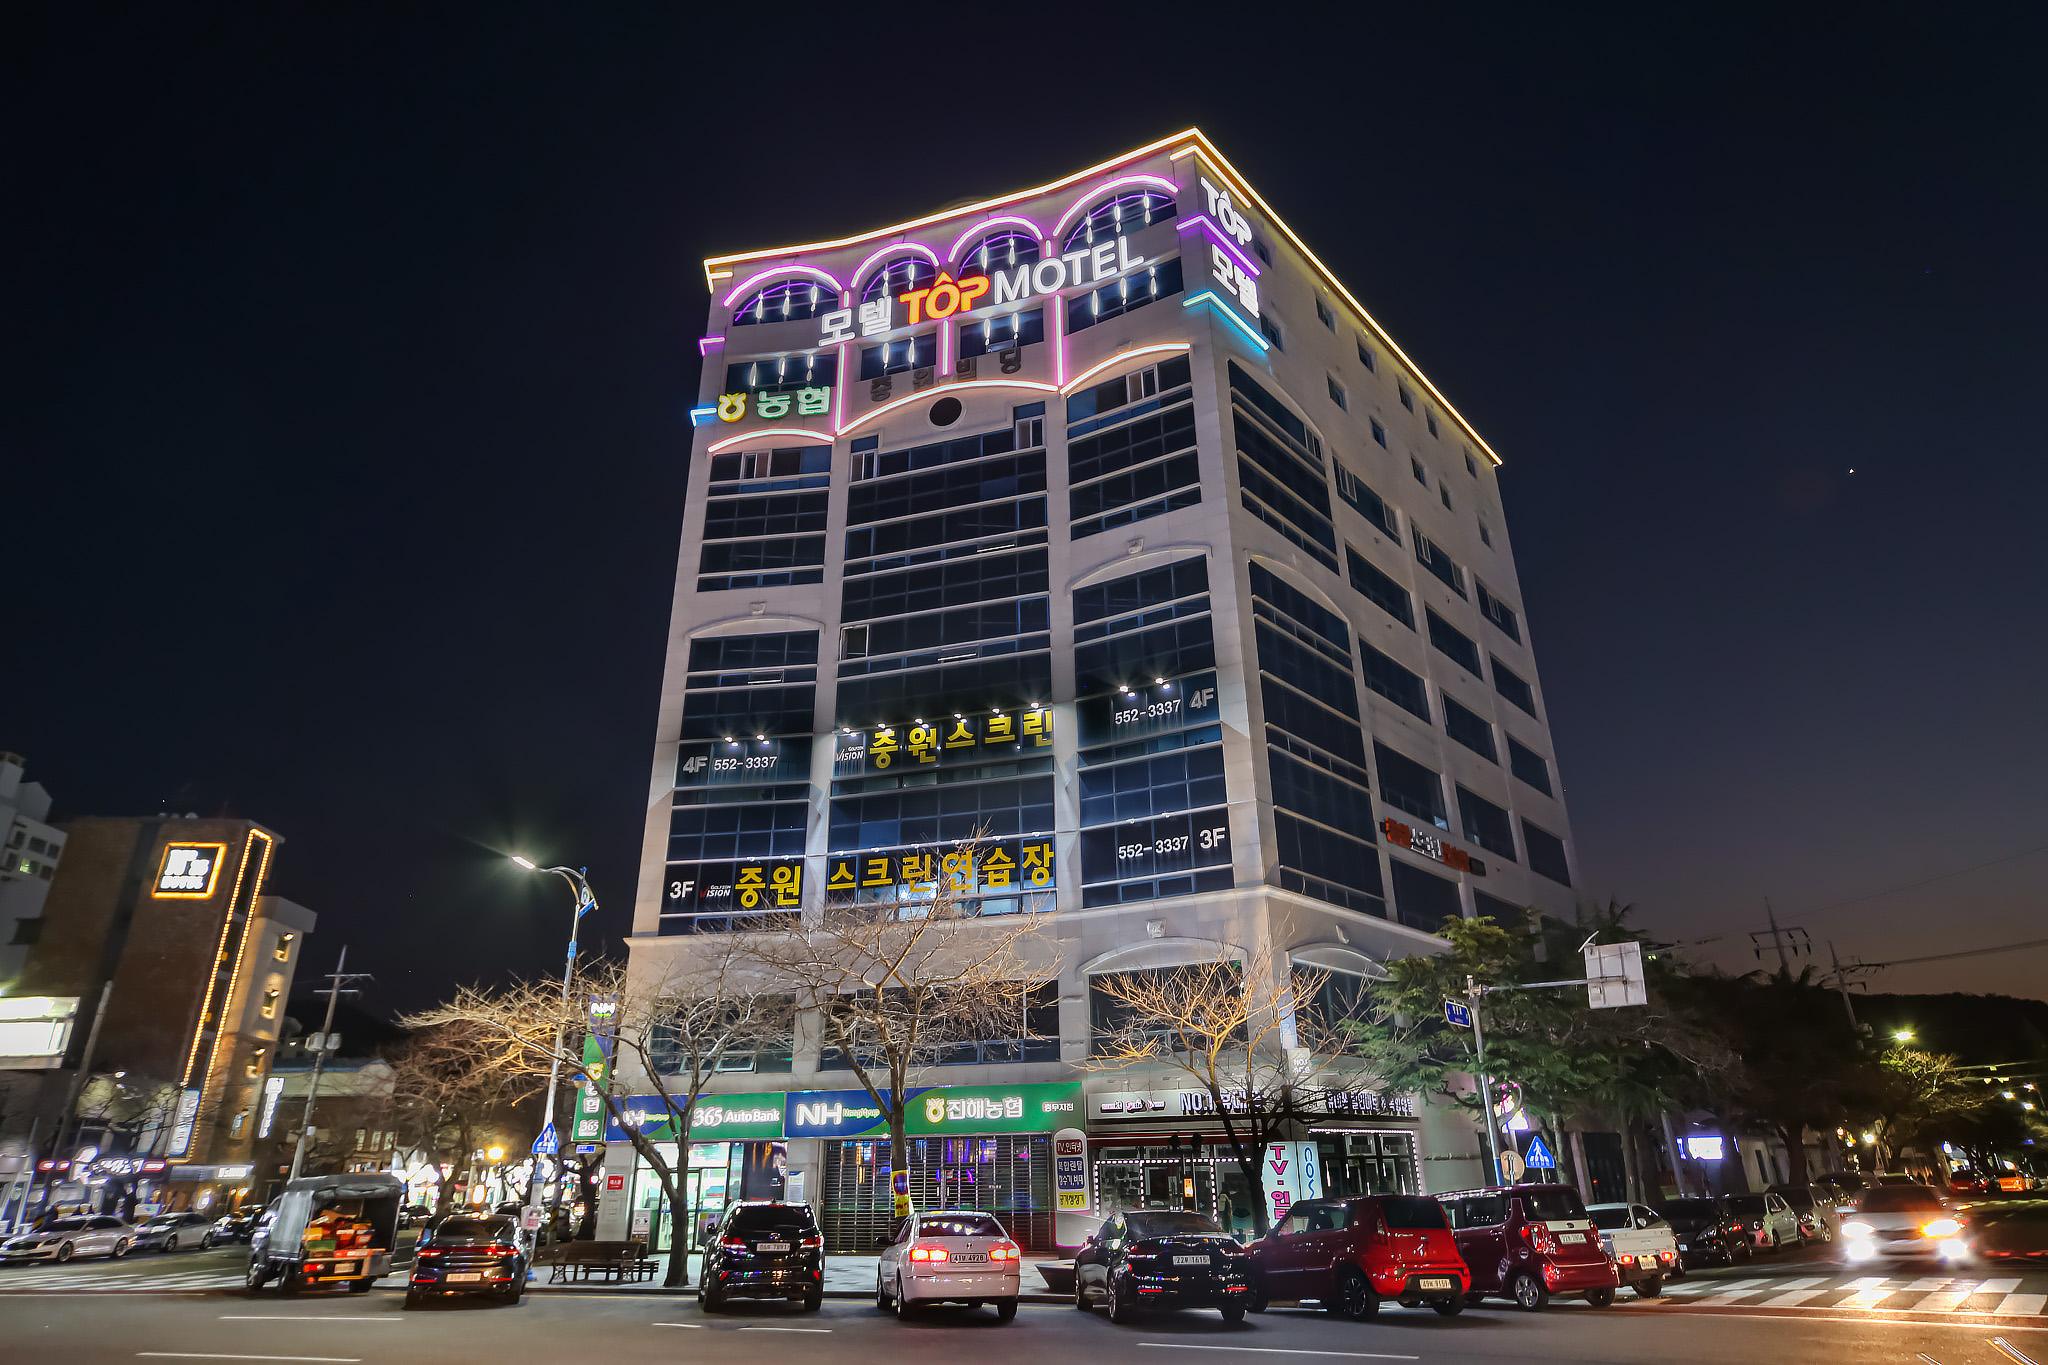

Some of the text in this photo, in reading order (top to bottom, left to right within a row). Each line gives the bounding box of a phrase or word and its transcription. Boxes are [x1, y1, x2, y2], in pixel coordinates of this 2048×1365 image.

[818, 295, 892, 347] 모텔
[993, 235, 1145, 305] MOTEL
[1211, 243, 1260, 319] 모텔
[757, 386, 831, 418] 농협
[1115, 687, 1214, 725] 552-3337 4F
[683, 756, 777, 774] 4F 552-3337
[836, 749, 864, 763] VISION
[1118, 827, 1226, 860] 552-3337 3F
[669, 881, 695, 899] 3F
[692, 1107, 723, 1127] 365
[796, 1102, 843, 1126] NH
[946, 1096, 1024, 1120] 진해농협
